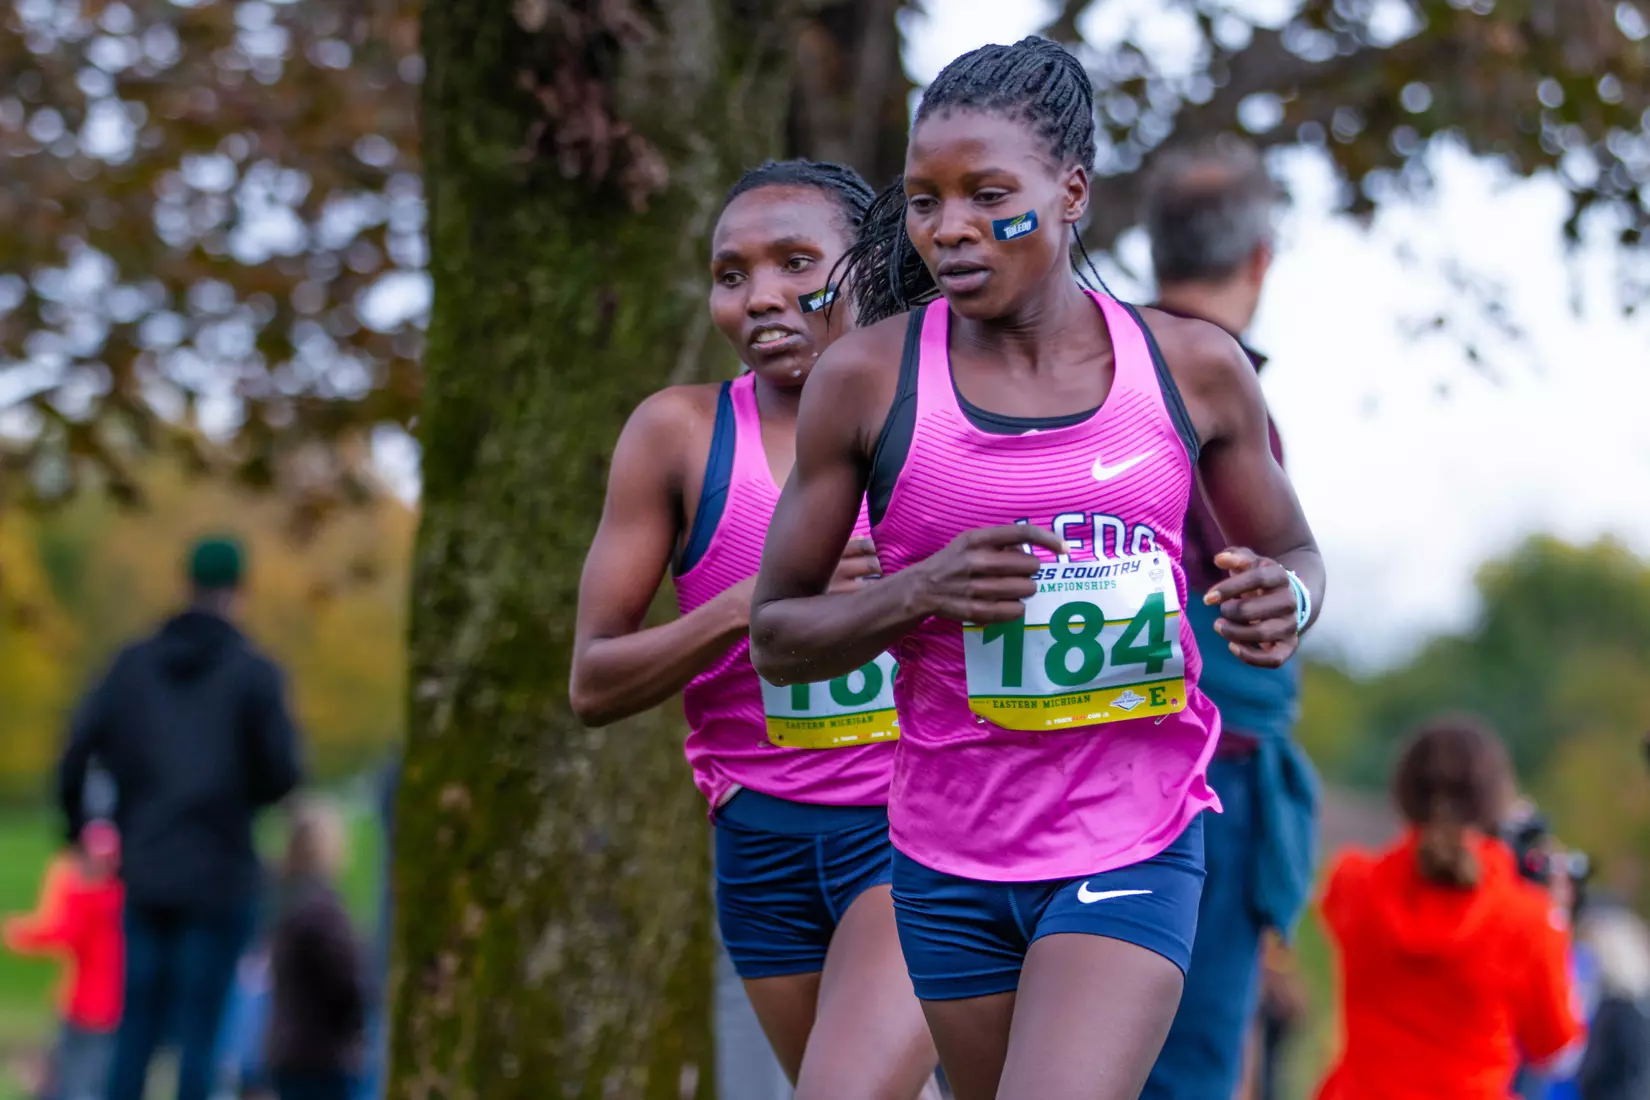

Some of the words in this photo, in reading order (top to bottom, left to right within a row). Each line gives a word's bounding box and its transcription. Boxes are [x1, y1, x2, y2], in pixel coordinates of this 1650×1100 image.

[1031, 567, 1057, 581] SS
[1061, 560, 1141, 579] COUNTRY
[1040, 580, 1117, 593] AMPIONSHIPS
[982, 592, 1173, 688] 184
[993, 699, 1038, 709] EASTERN
[1043, 695, 1091, 708] MICHIGAN
[1148, 685, 1167, 707] E
